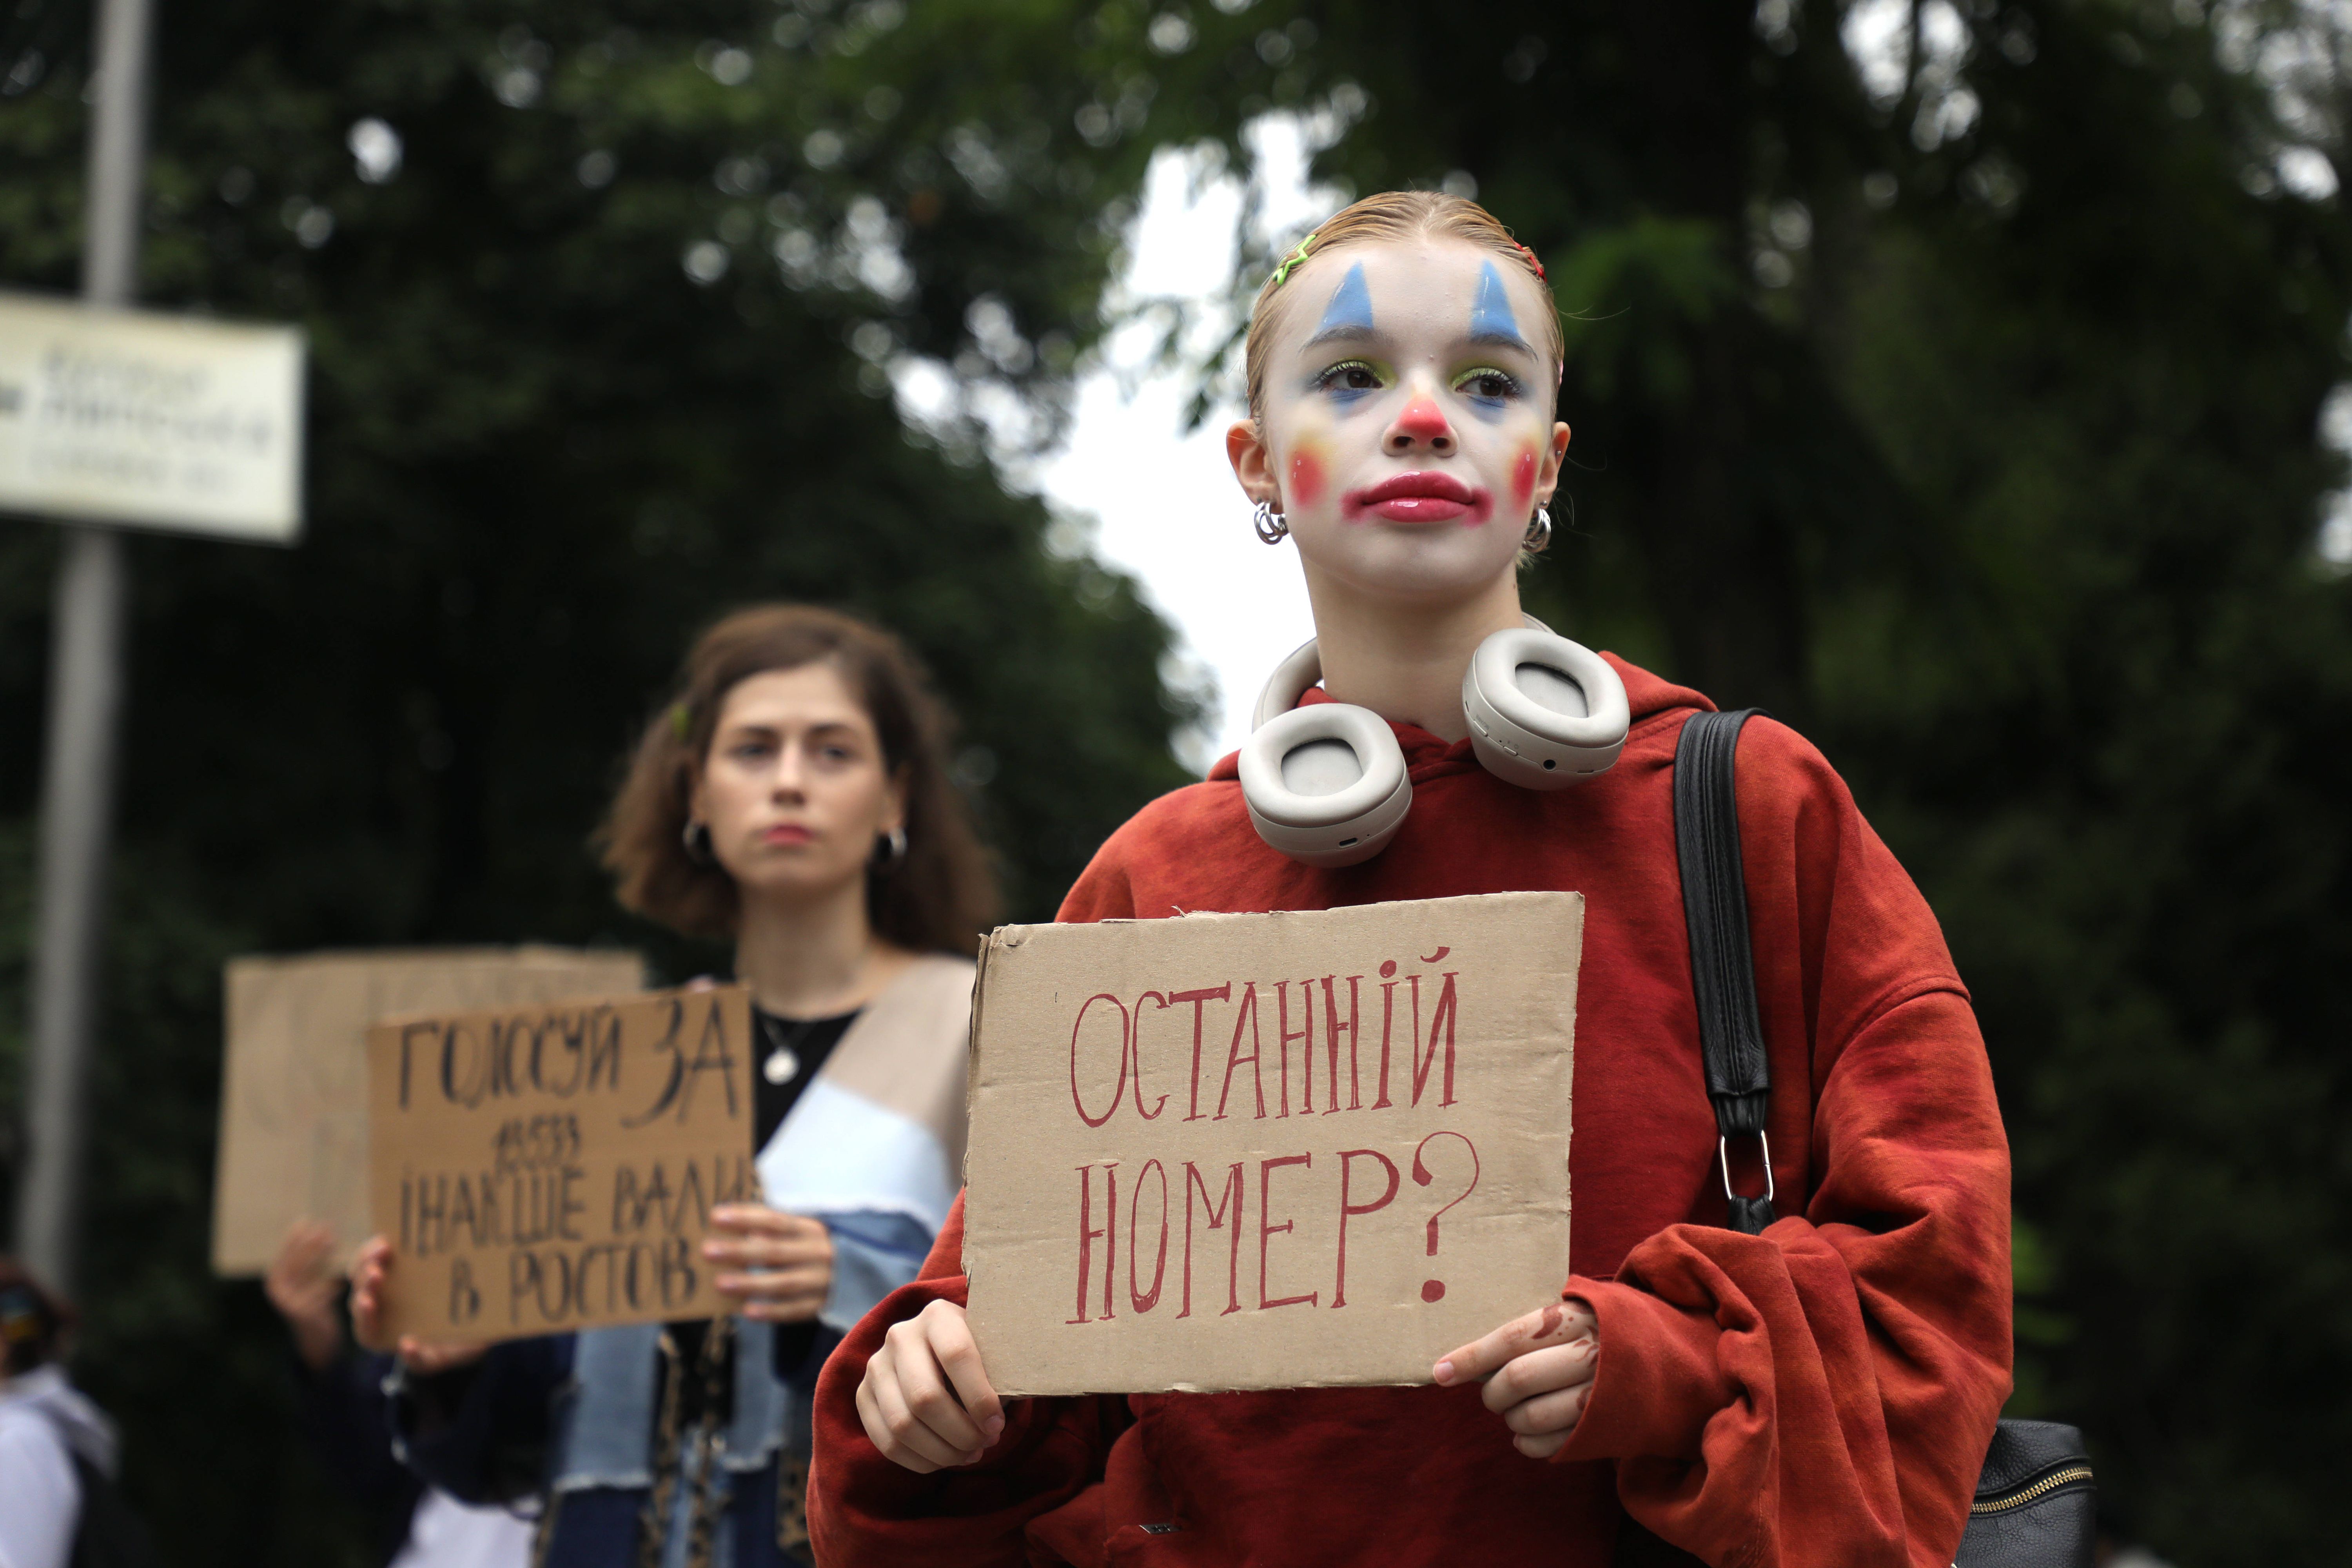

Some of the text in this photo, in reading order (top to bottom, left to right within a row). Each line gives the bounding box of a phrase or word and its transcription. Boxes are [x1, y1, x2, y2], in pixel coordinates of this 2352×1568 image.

[400, 996, 737, 1130] ГОЛОСУЙ ЗА
[1071, 946, 1459, 1128] ОСТАННІЙ
[398, 1166, 586, 1257] ІНАКШЕ
[1065, 1131, 1479, 1324] НОМЕР?
[450, 1240, 698, 1326] В РОСТОВ
